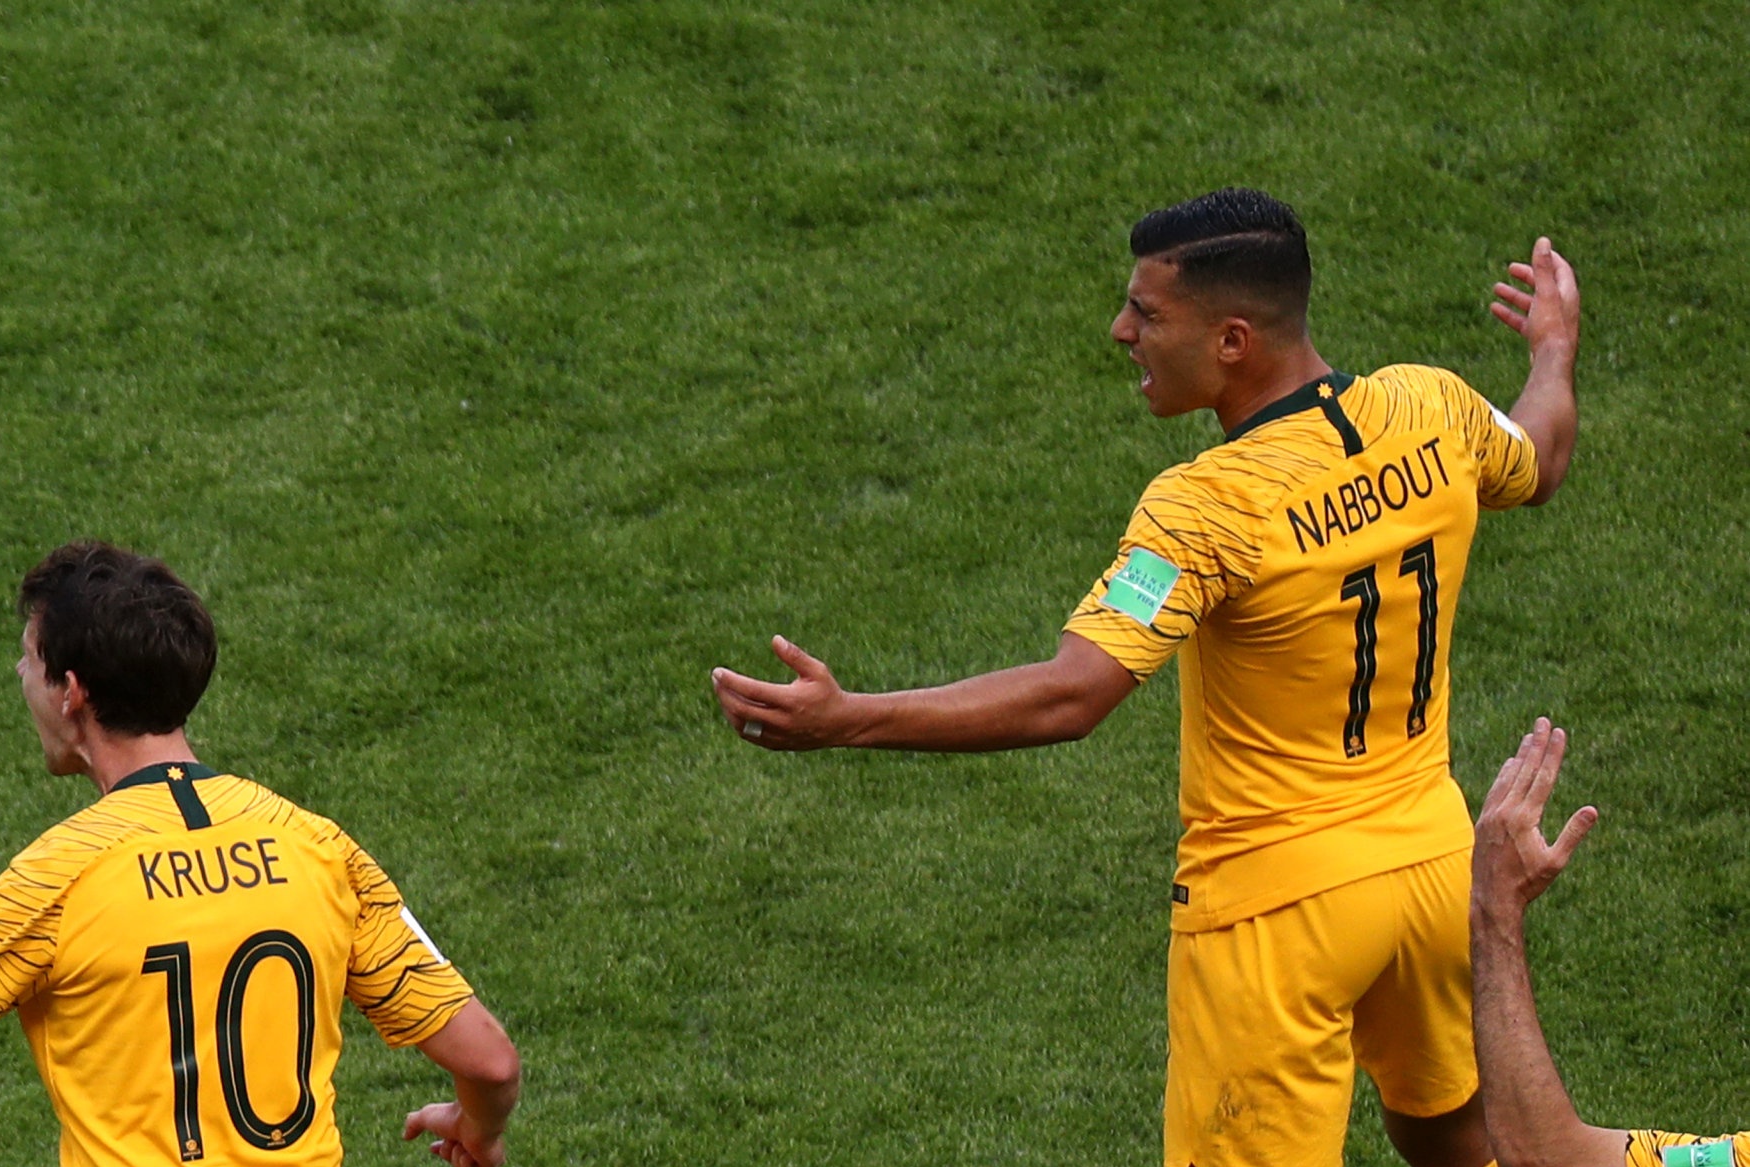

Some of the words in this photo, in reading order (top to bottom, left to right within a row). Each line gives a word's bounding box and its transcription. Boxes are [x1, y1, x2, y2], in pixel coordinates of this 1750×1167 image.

[1286, 437, 1451, 554] NABBOUT
[1127, 565, 1167, 590] IVING
[1136, 593, 1156, 608] FIFA
[1340, 537, 1440, 759] 11
[138, 838, 288, 900] KRUSE
[141, 929, 316, 1162] 10
